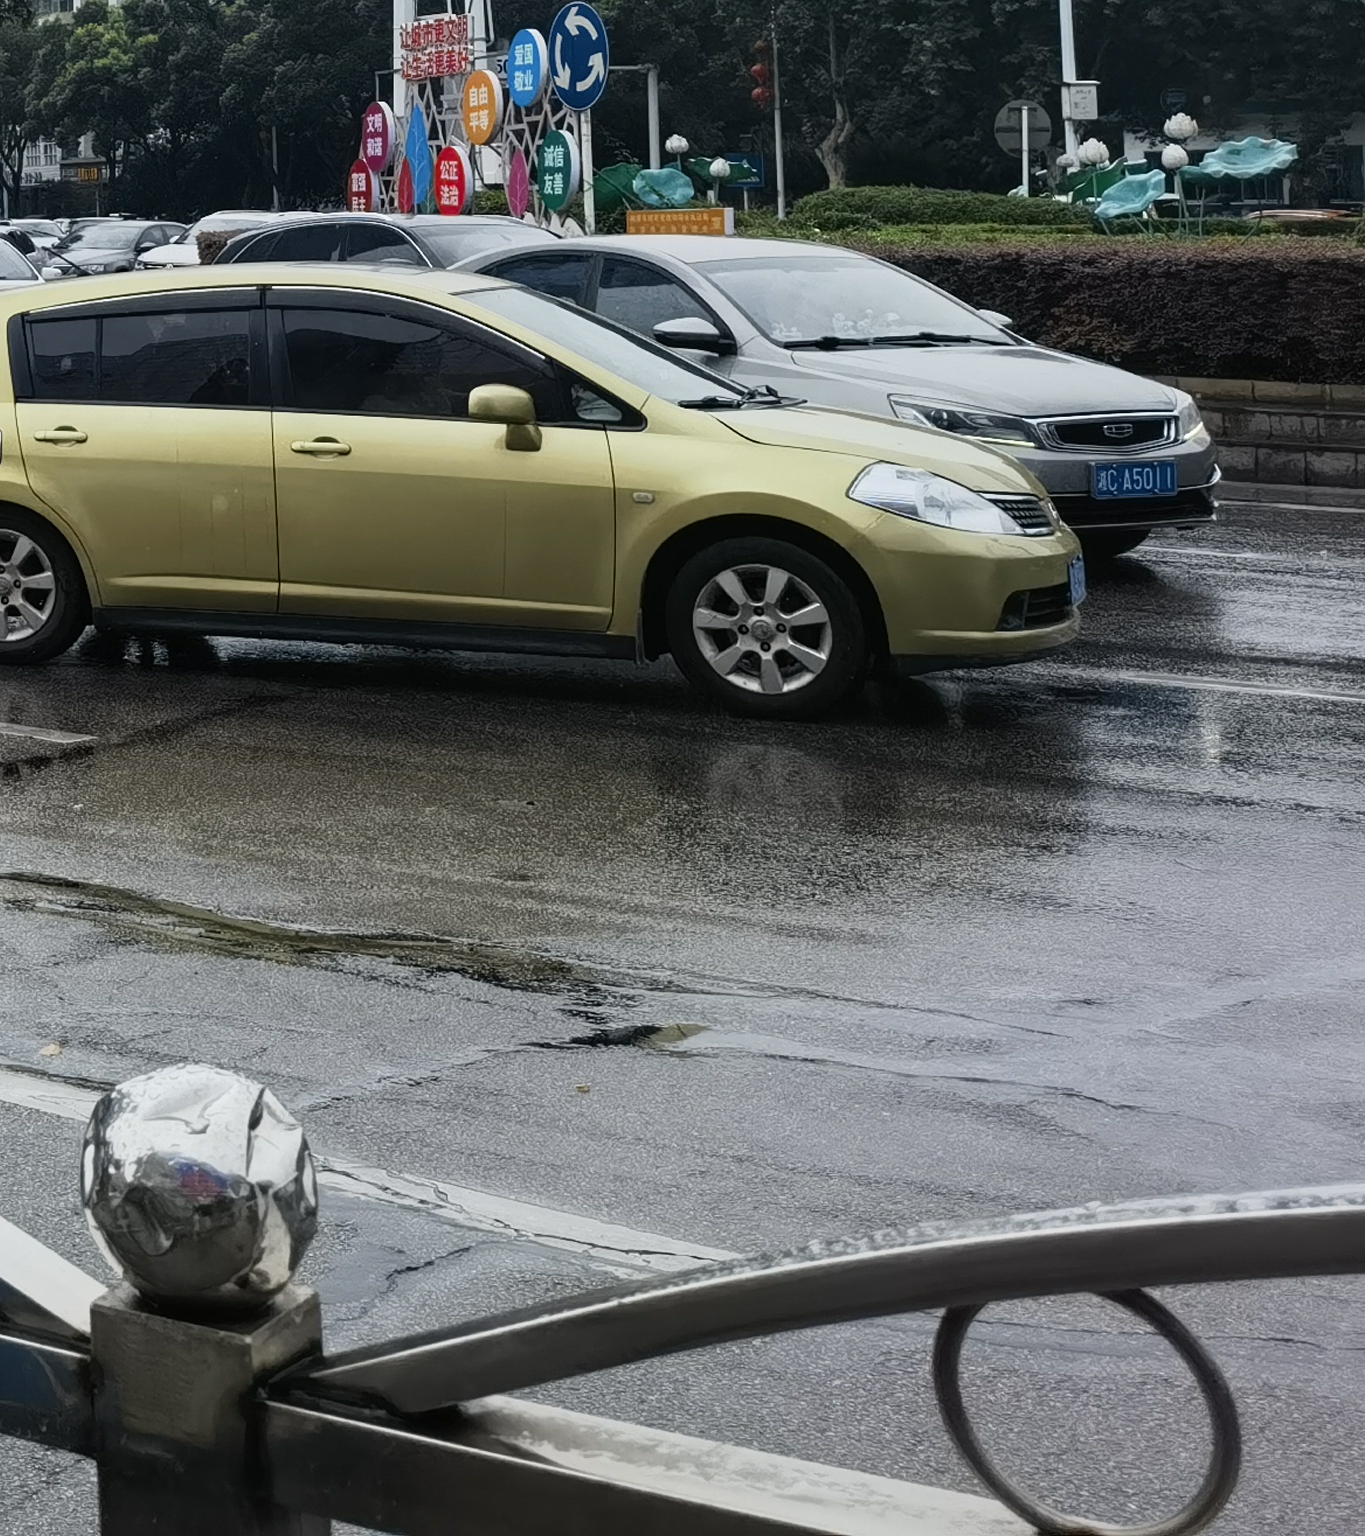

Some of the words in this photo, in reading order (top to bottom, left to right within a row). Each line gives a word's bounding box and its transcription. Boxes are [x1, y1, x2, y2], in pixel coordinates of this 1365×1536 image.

[400, 14, 469, 49] 让城市更文明
[401, 46, 470, 80] 让生活更美好
[514, 43, 534, 65] 爱国
[514, 69, 534, 92] 敬业
[468, 84, 489, 107] 自由
[366, 113, 383, 132] 文明
[468, 109, 489, 133] 平等
[366, 137, 383, 156] 和谐
[543, 145, 565, 168] 诚信
[351, 173, 366, 191] 富强
[440, 161, 459, 181] 公正
[543, 172, 564, 195] 友善
[440, 185, 459, 207] 法治
